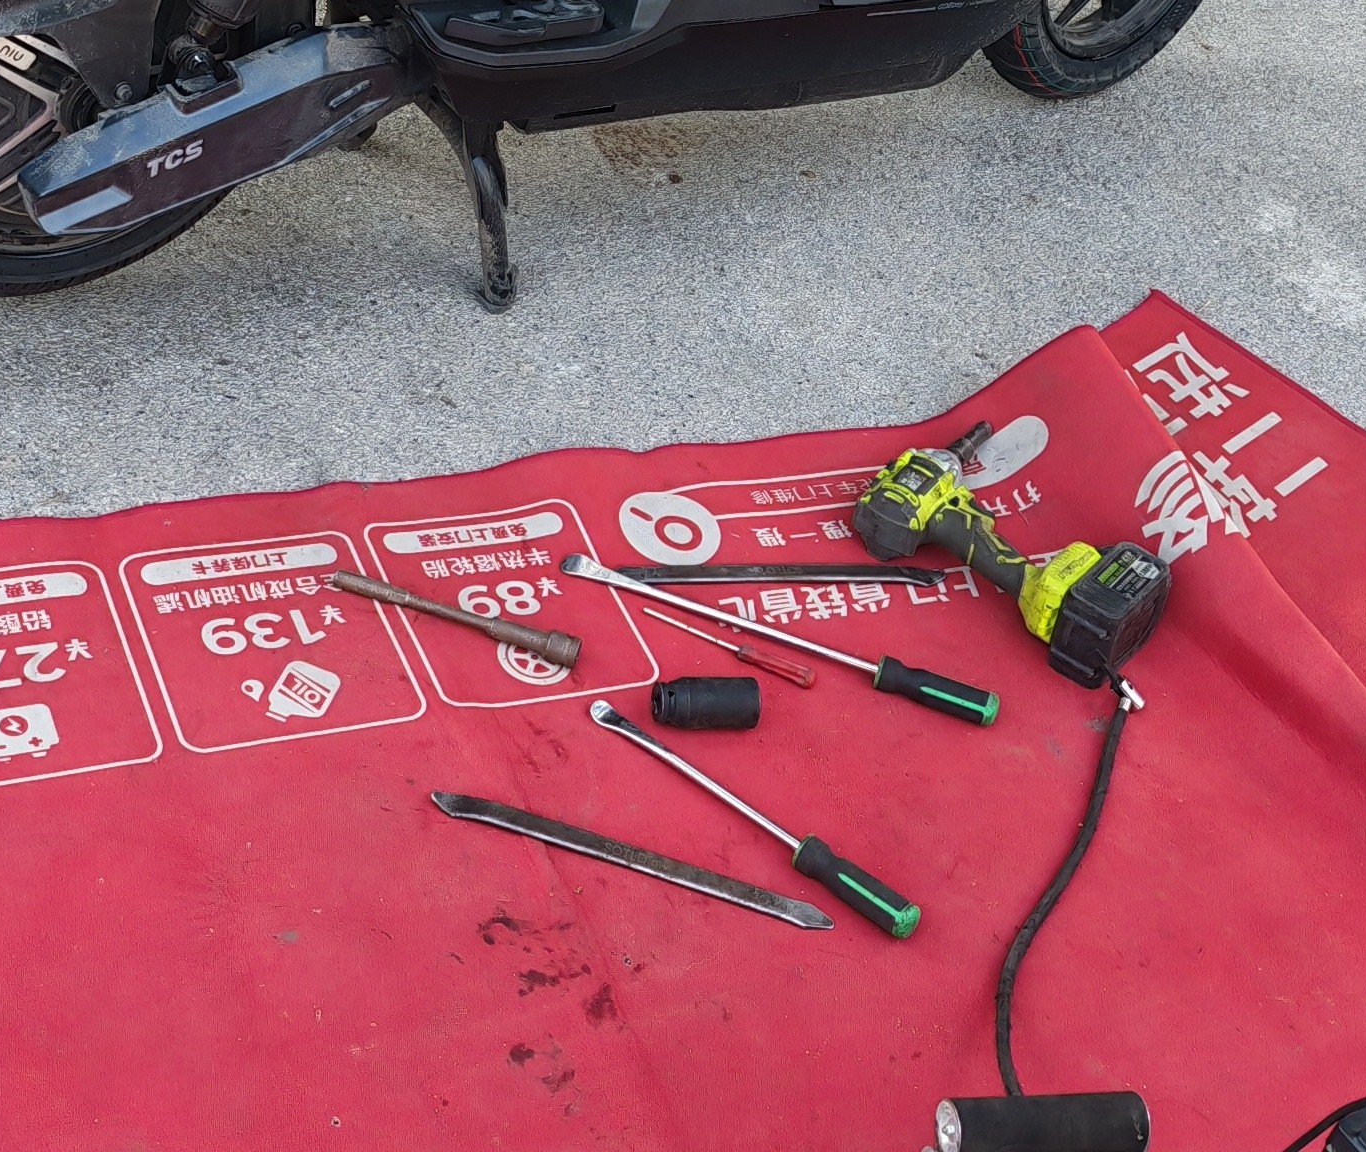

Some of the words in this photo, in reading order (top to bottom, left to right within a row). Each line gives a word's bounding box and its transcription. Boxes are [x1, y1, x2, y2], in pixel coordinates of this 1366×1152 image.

[146, 139, 204, 178] TCS
[417, 522, 528, 547] 免费上门安装
[192, 551, 288, 575] 上门保养卡
[421, 548, 552, 579] 半热熔轮胎
[292, 677, 322, 705] OIL
